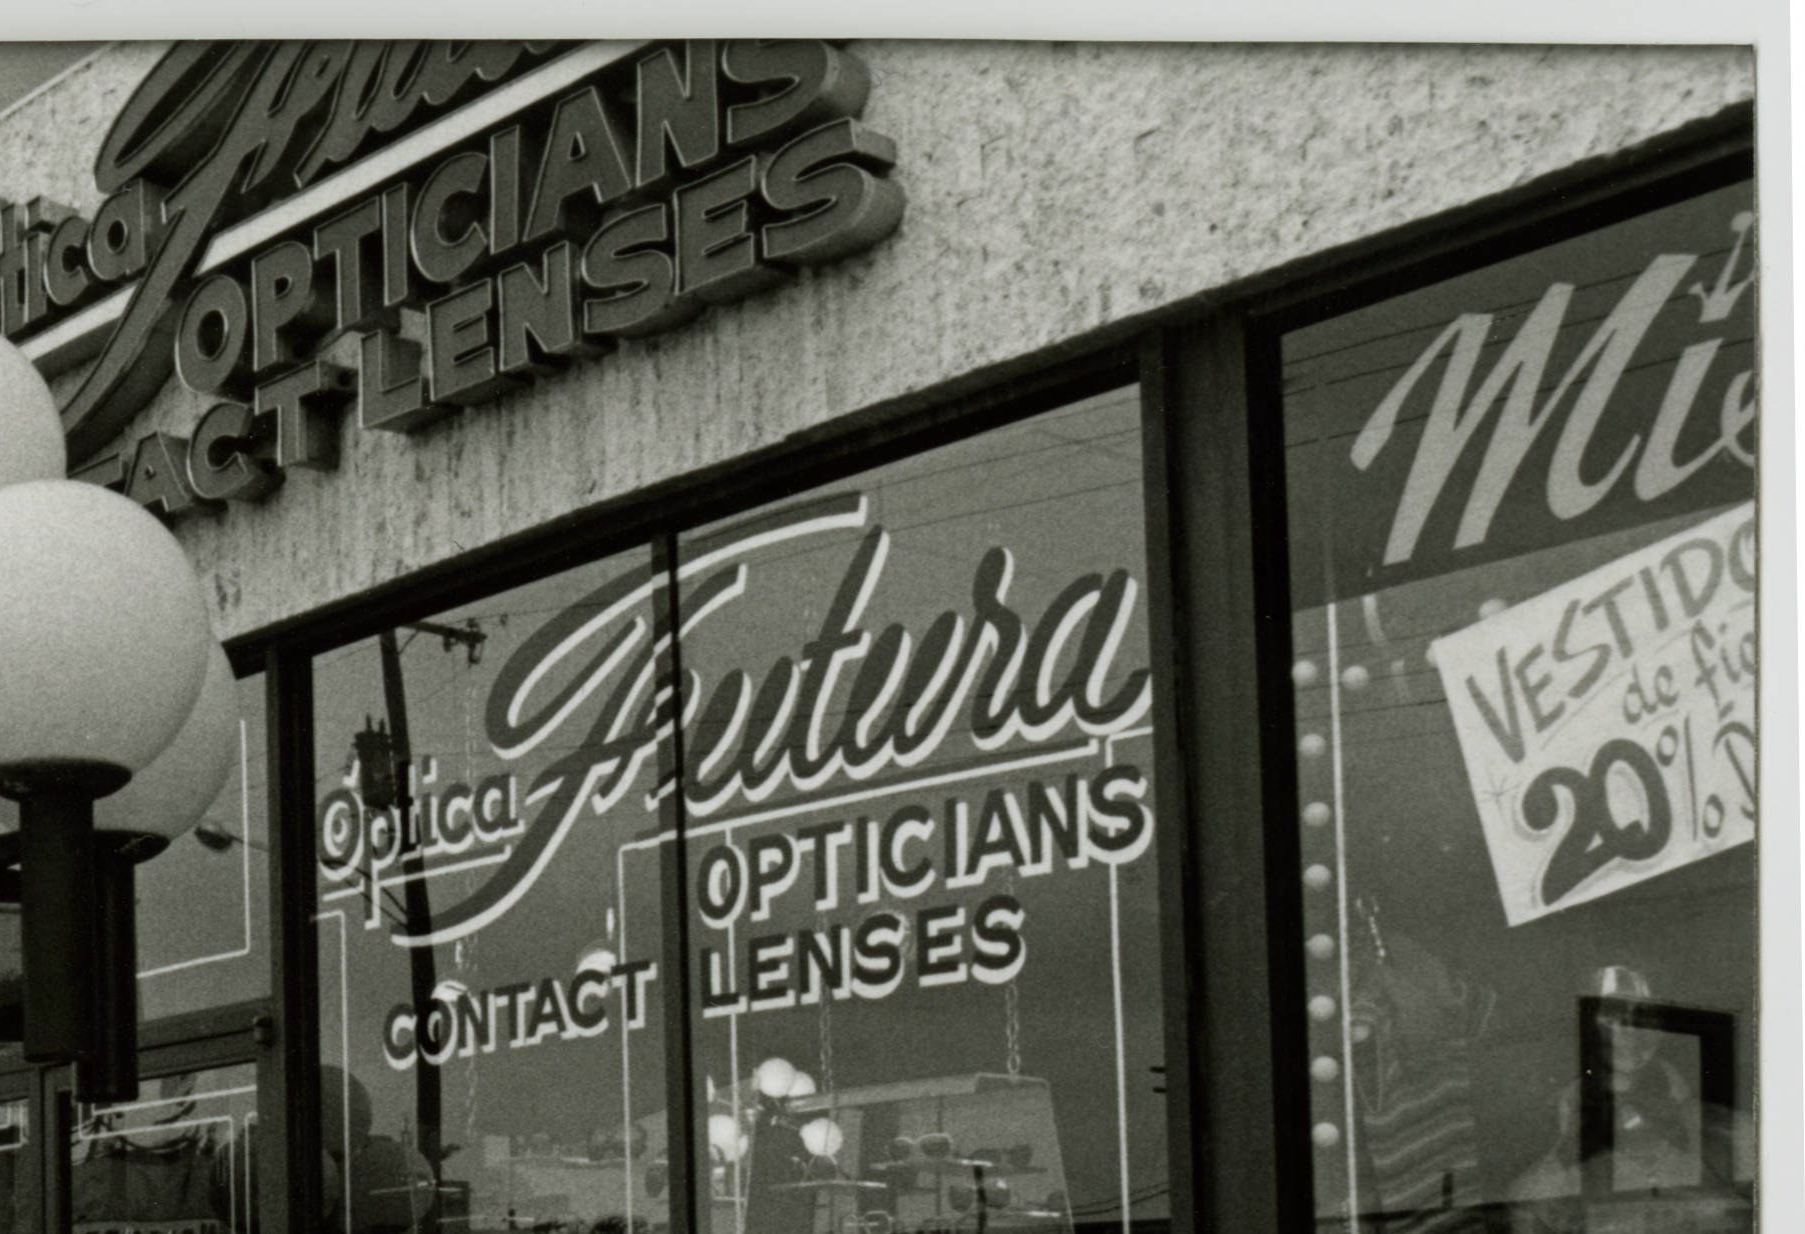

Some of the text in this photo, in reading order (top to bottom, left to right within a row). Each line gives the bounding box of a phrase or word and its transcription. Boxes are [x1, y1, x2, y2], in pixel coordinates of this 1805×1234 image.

[174, 38, 839, 396] OPTICIANS
[357, 114, 879, 430] LENSES
[390, 490, 1156, 948] Futura
[1622, 663, 1681, 725] de
[695, 763, 1156, 928] OPTICIANS
[382, 893, 1027, 1071] CONTACT LENSES
